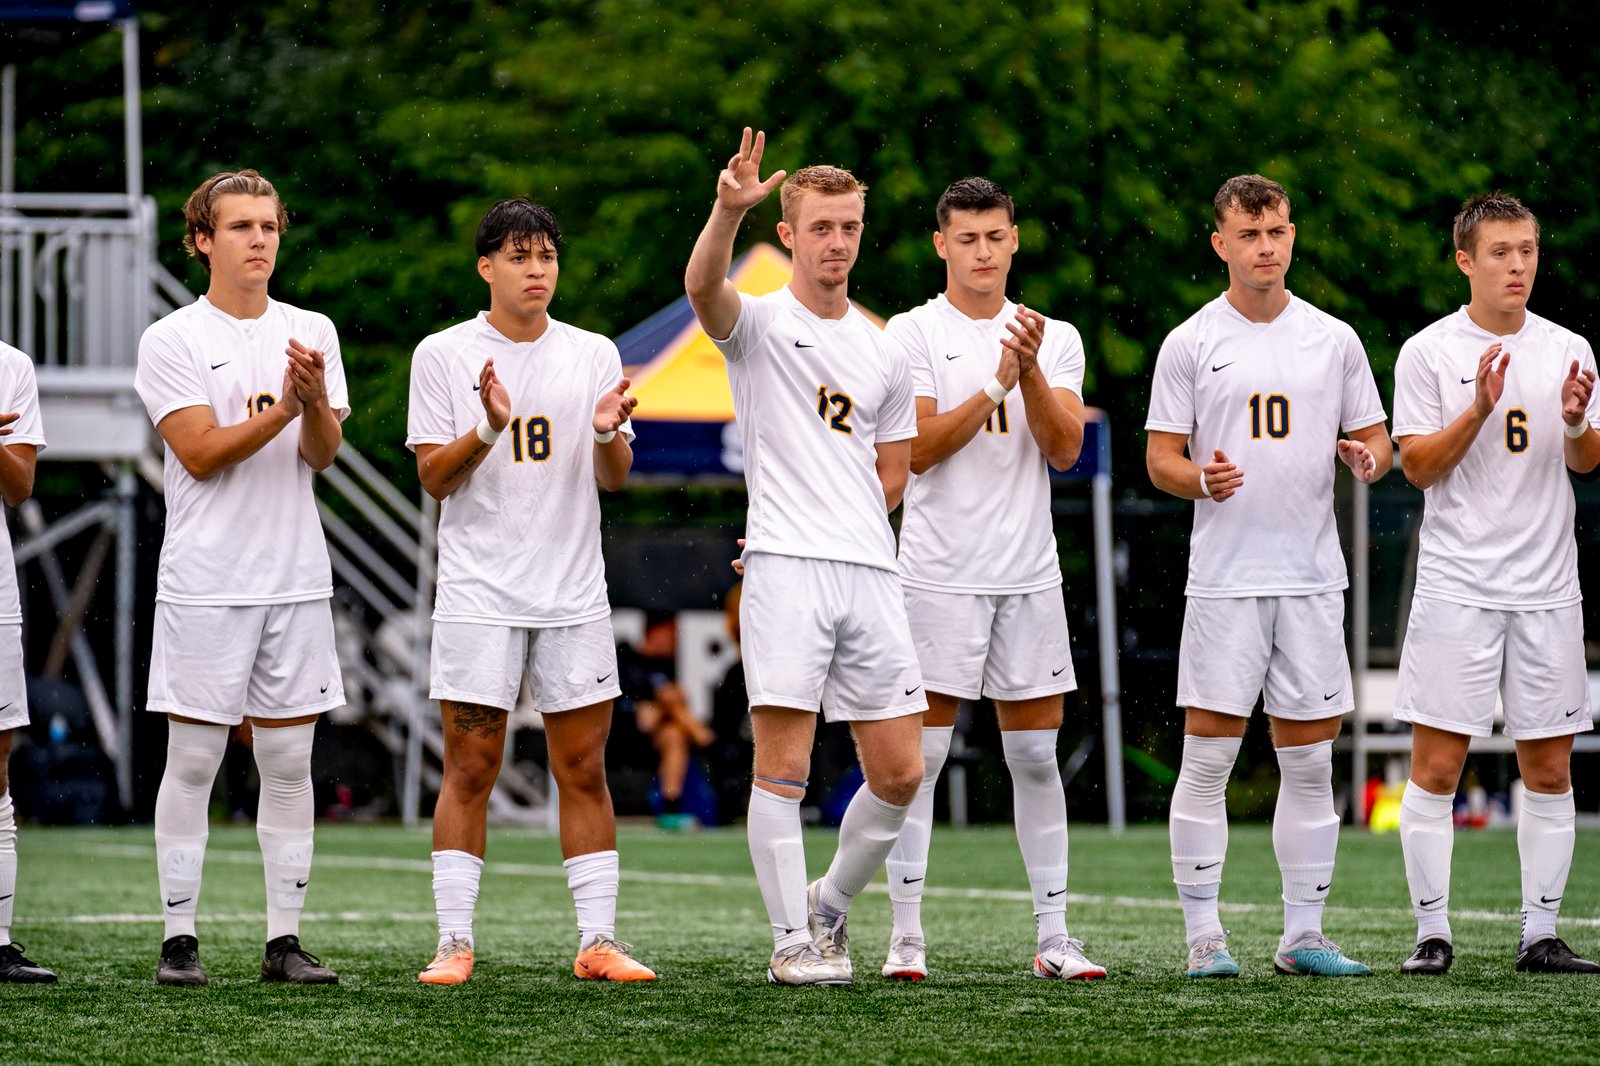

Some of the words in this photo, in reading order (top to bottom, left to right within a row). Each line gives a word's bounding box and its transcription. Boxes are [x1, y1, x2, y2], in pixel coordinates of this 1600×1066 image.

[817, 385, 854, 436] 12
[1248, 393, 1291, 440] 10
[1504, 407, 1529, 454] 6
[510, 415, 552, 463] 18
